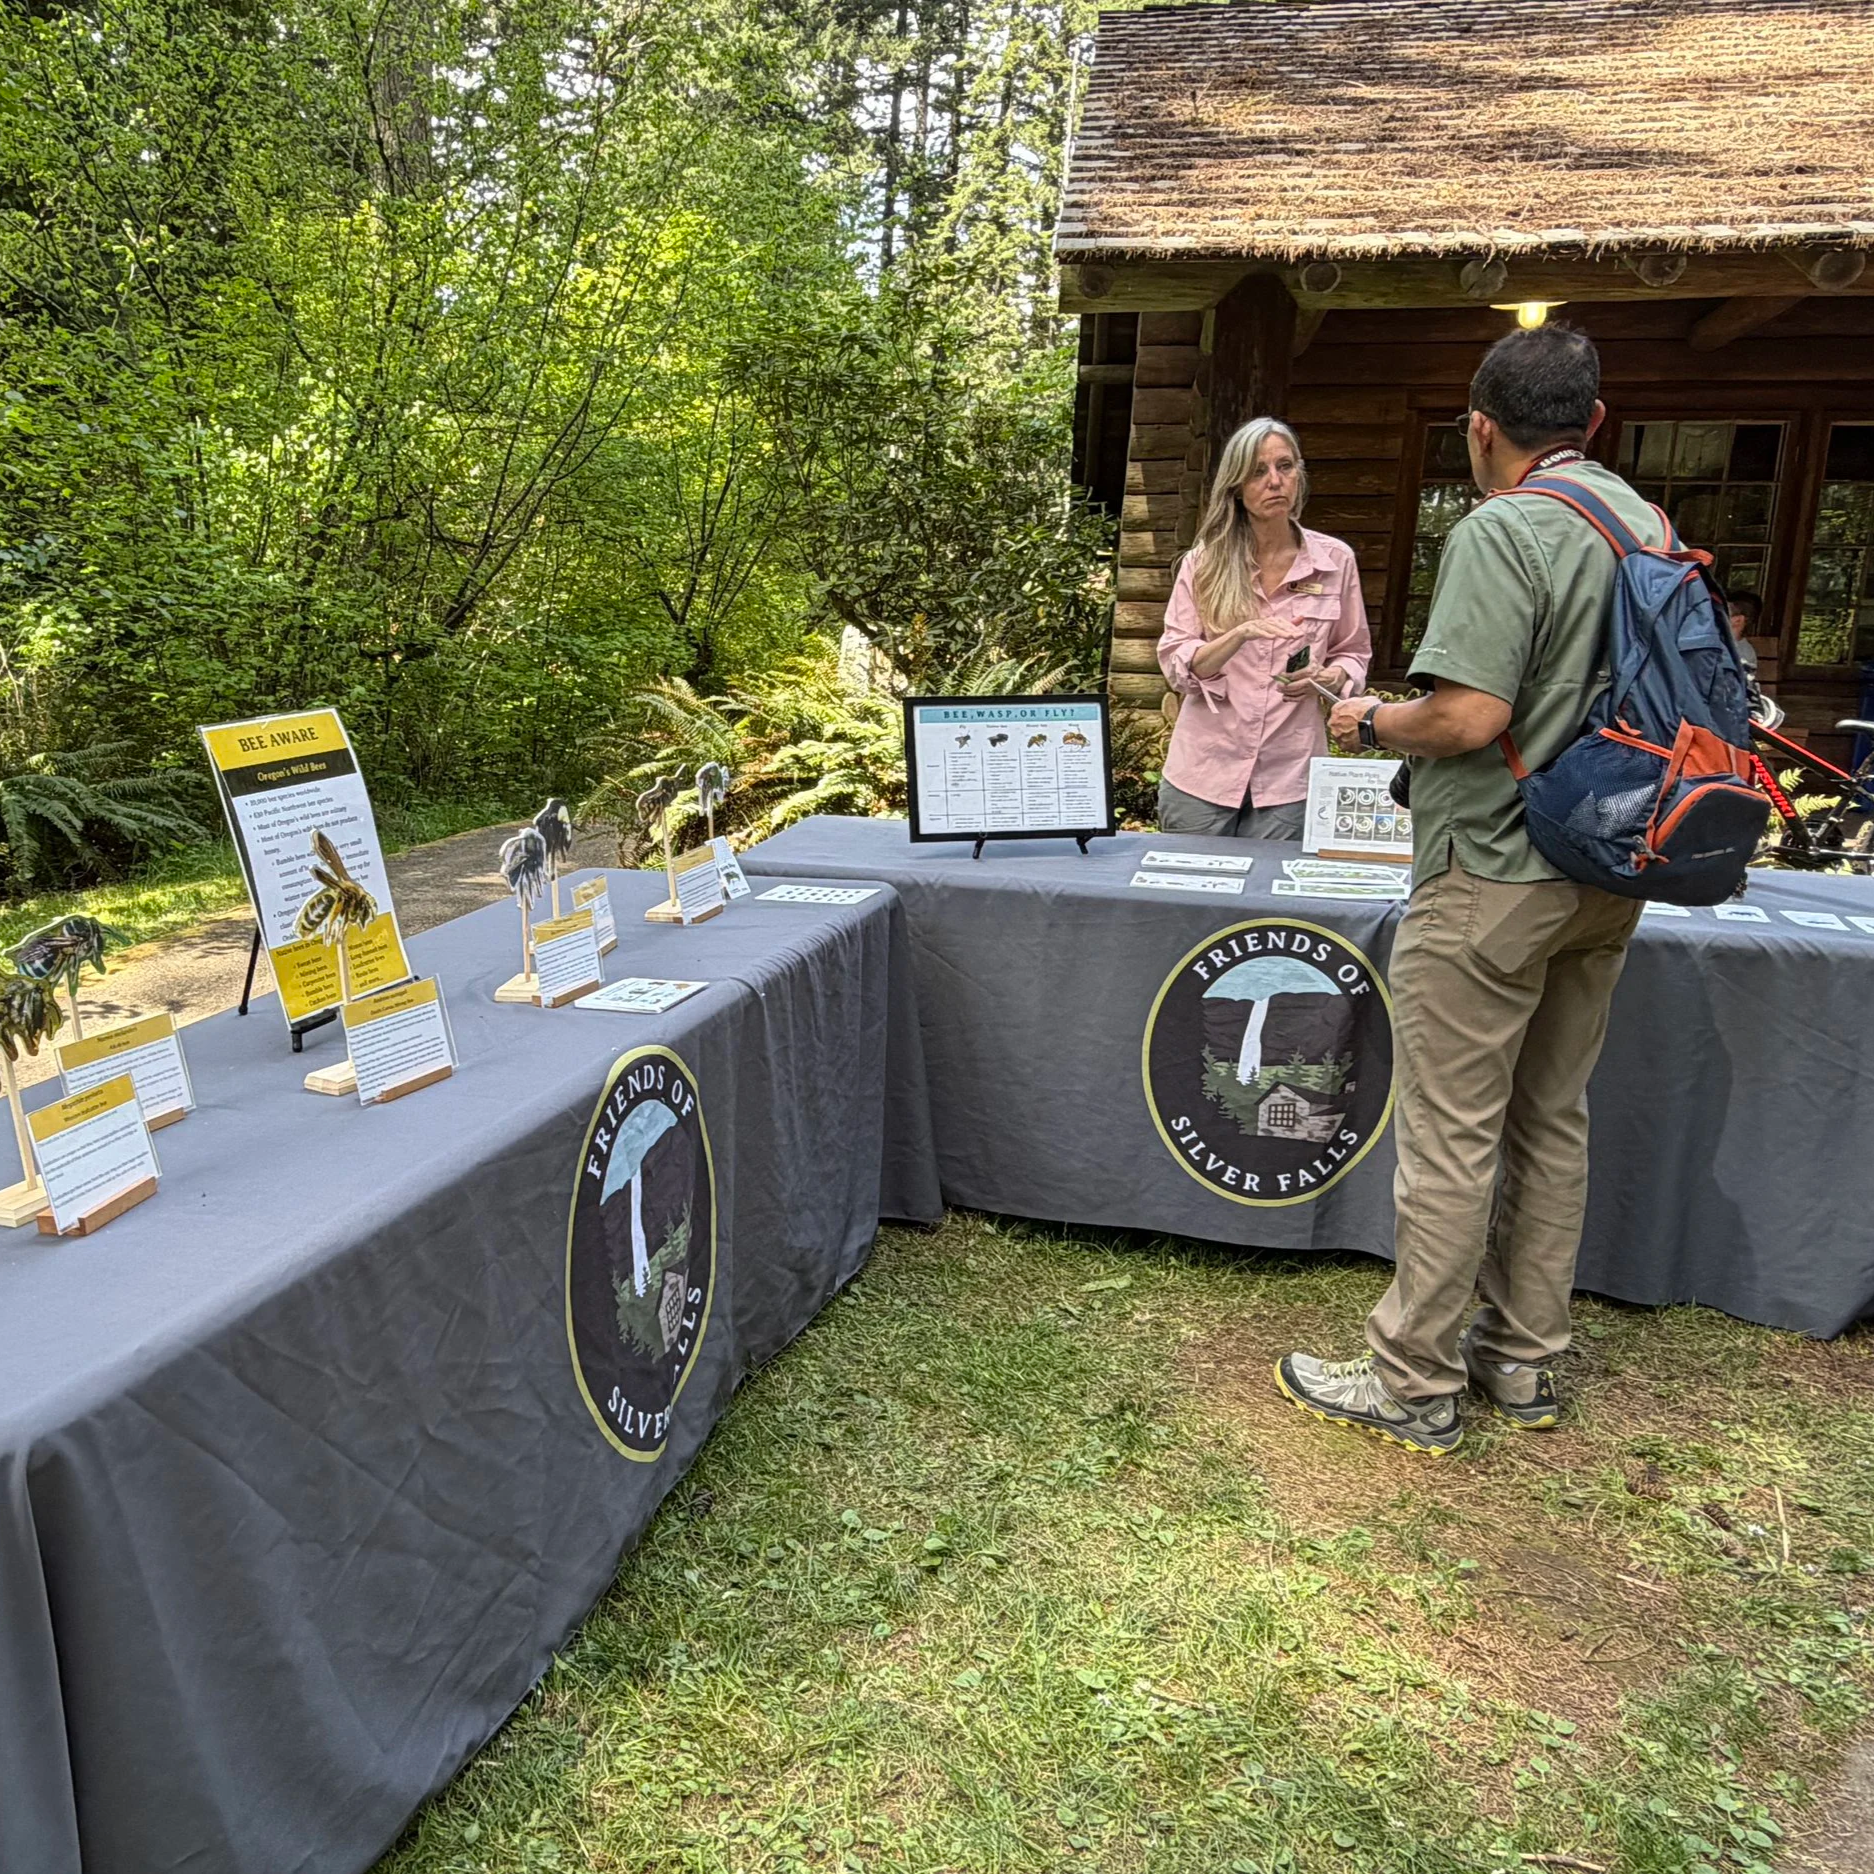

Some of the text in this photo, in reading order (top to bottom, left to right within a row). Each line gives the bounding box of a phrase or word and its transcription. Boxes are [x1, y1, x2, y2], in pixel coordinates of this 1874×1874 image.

[1540, 450, 1585, 468] Canon
[1020, 710, 1037, 718] OR
[1045, 709, 1076, 718] FLY?
[238, 727, 319, 753] BEE AWARE
[257, 762, 327, 782] Oregon's Wild Bees
[1192, 931, 1371, 997] FRIENDS OF
[587, 1065, 695, 1180] FRIENDS OF
[1170, 1116, 1358, 1192] SILVER FALLS
